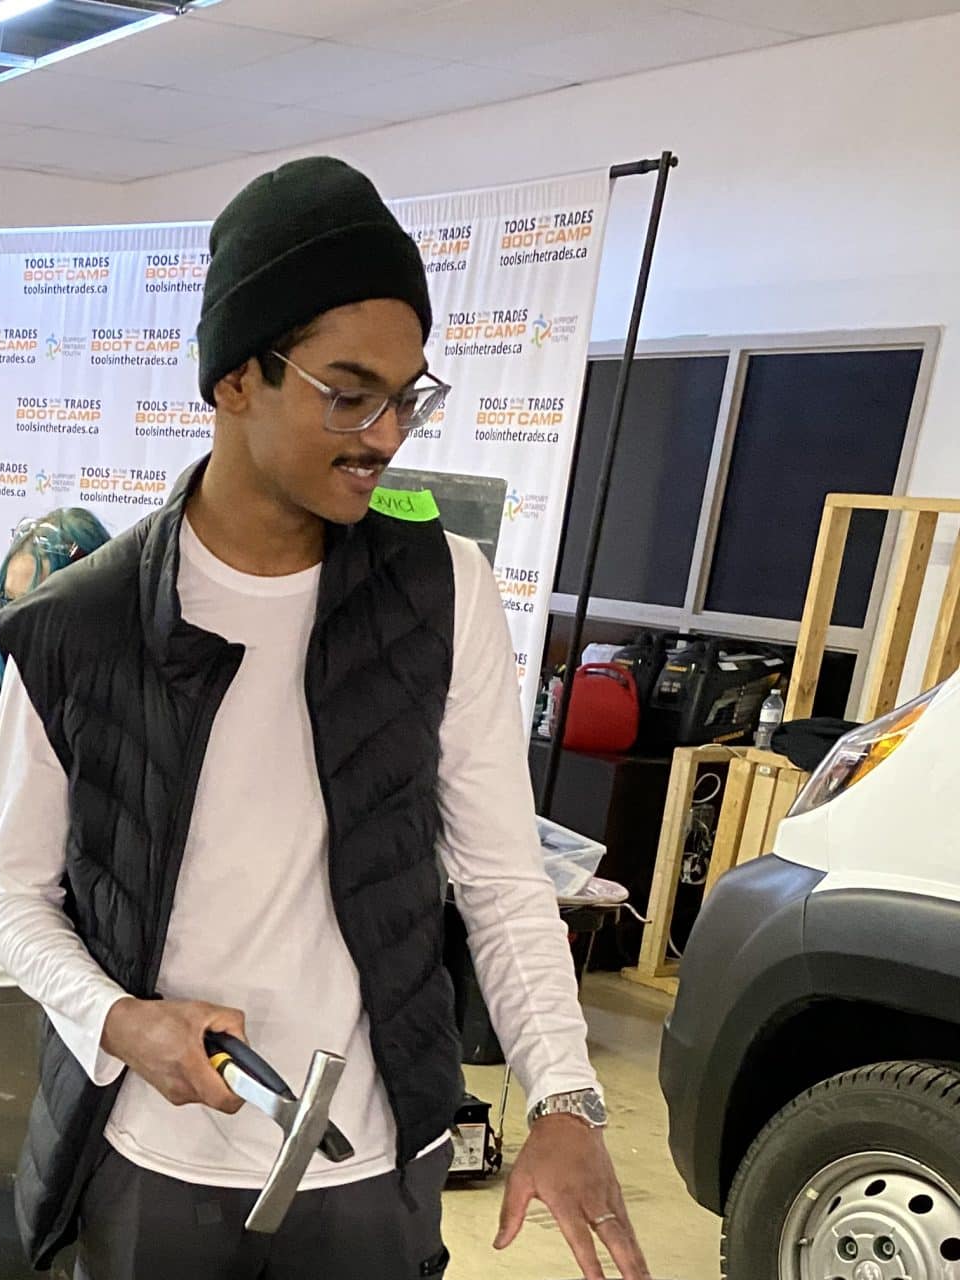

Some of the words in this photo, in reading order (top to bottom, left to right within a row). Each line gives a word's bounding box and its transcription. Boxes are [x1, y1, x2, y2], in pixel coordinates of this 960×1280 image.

[505, 218, 536, 233] TOOLS
[555, 210, 593, 226] TRADES
[439, 226, 471, 240] TRADES
[501, 232, 543, 249] BOOT
[545, 226, 592, 244] CAMP
[25, 258, 54, 268] TOOLS
[73, 257, 109, 267] TRADES
[147, 255, 179, 266] TOOLS
[500, 248, 587, 266] toolsinthetrades.ca
[24, 269, 64, 280] BOOT
[66, 268, 109, 280] CAMP
[146, 267, 190, 278] BOOT
[24, 284, 107, 294] toolsinthetrades.ca
[449, 313, 475, 324] TOOLS
[494, 309, 528, 322] TRADES
[4, 329, 37, 339] TRADES
[92, 329, 122, 339] TOOLS
[144, 329, 180, 339] TRADES
[445, 326, 484, 340] BOOT
[484, 324, 526, 339] CAMP
[91, 341, 133, 351] BOOT
[135, 341, 180, 351] CAMP
[91, 355, 177, 365] toolsinthetrades.ca
[17, 398, 47, 407] TOOLS
[64, 399, 101, 409] TRADES
[137, 401, 167, 411] TOOLS
[480, 398, 508, 410] TOOLS
[528, 398, 564, 410] TRADES
[16, 408, 56, 419] BOOT
[57, 410, 101, 421] CAMP
[135, 412, 178, 423] BOOT
[180, 414, 216, 424] CAM
[477, 412, 516, 425] BOOT
[518, 413, 563, 425] CAMP
[17, 423, 99, 434] toolsinthetrades.ca
[476, 429, 558, 442] toolsinthetrades.ca
[81, 467, 110, 478] TOOLS
[130, 470, 166, 480] TRADES
[80, 478, 121, 490] BOOT
[123, 480, 166, 492] CAMP
[80, 491, 164, 505] toolsinthetrades.ca
[506, 568, 540, 583] TRADES
